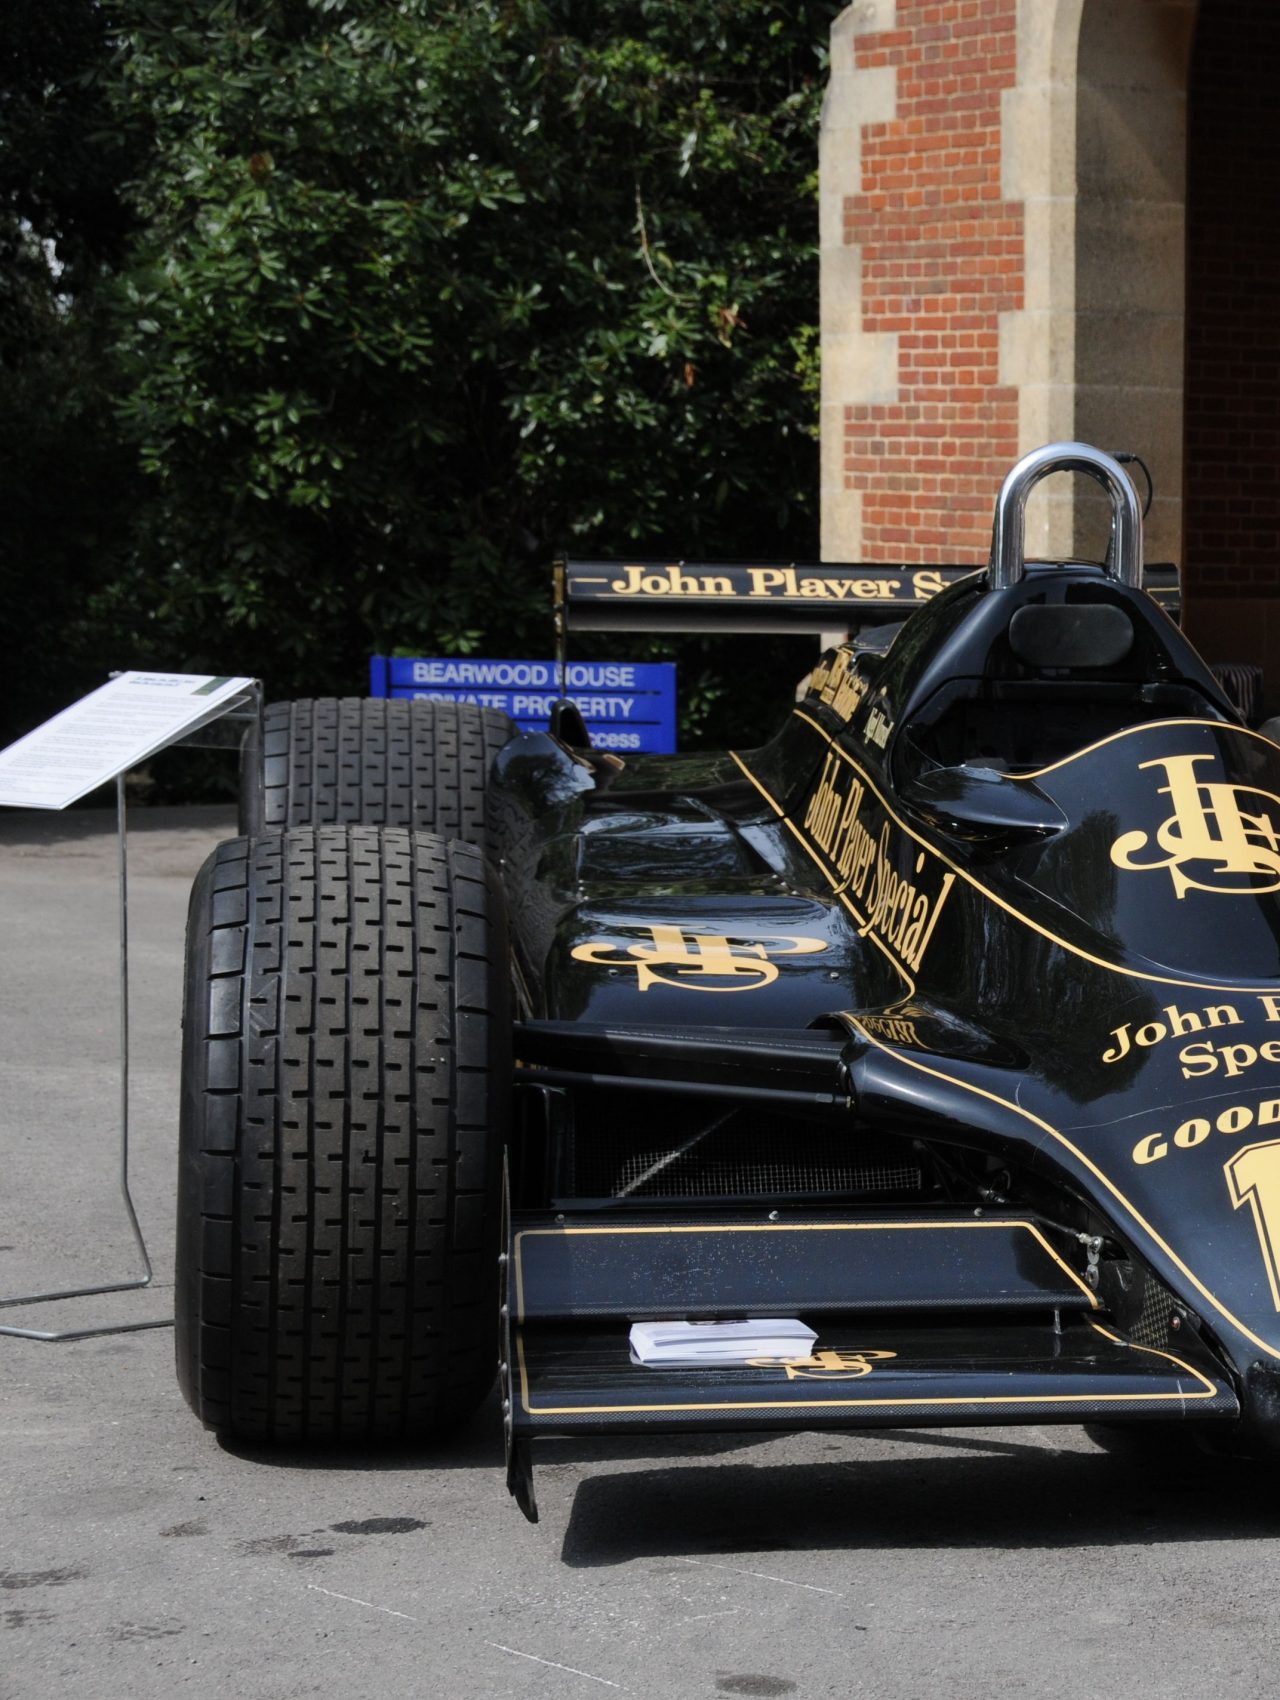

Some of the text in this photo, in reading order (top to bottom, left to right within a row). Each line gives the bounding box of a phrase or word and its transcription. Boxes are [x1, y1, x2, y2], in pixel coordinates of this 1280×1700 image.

[612, 566, 956, 600] John Player S
[413, 661, 635, 688] BEARWOOD HOUSE
[513, 696, 635, 718] PROERTY
[588, 733, 641, 749] ccess
[804, 752, 841, 860] John
[832, 777, 876, 895] Player
[857, 821, 956, 974] Special
[1102, 1003, 1243, 1064] John
